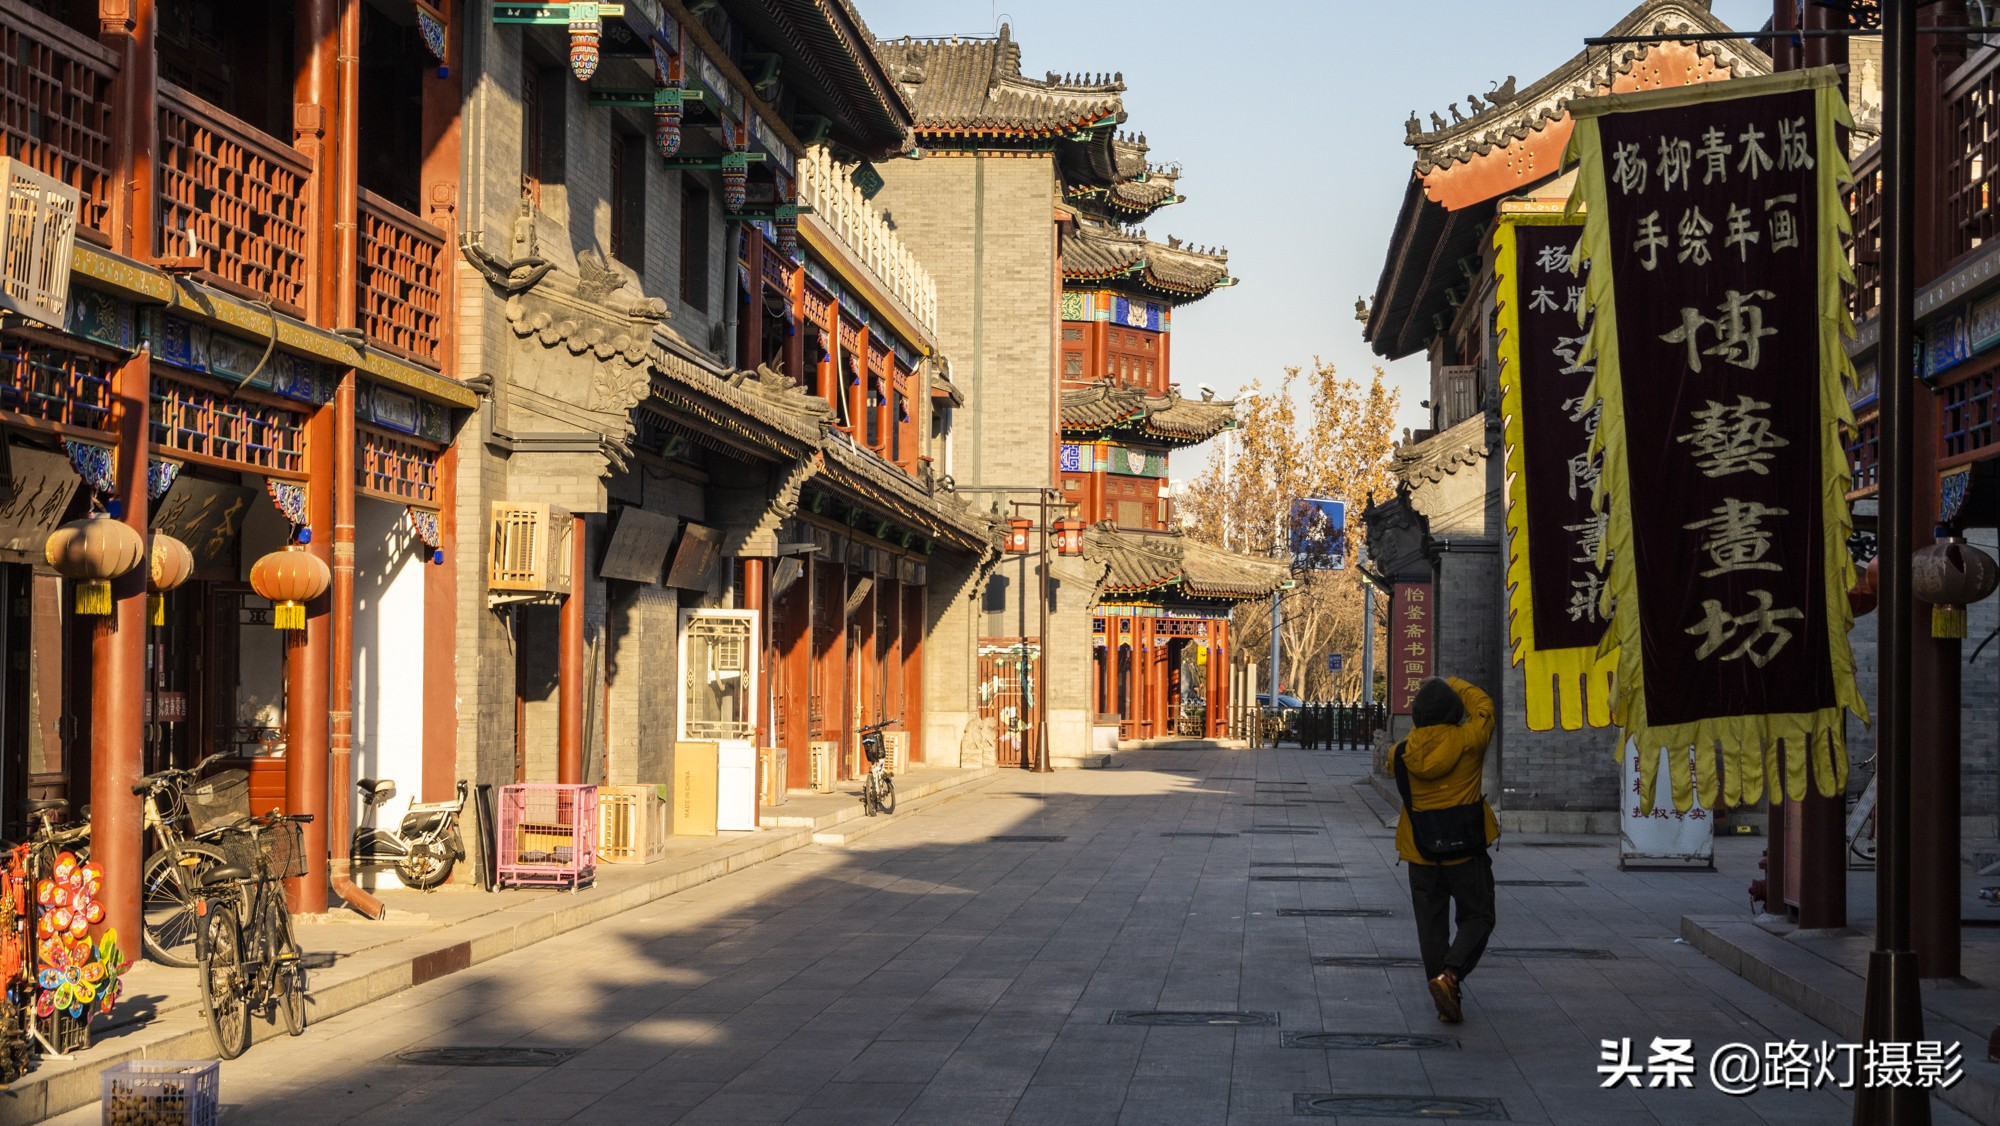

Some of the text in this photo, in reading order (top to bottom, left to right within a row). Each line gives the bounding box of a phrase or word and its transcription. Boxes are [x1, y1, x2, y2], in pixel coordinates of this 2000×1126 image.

[1612, 116, 1815, 195] 杨柳青木版
[1633, 193, 1799, 271] 手绘年画
